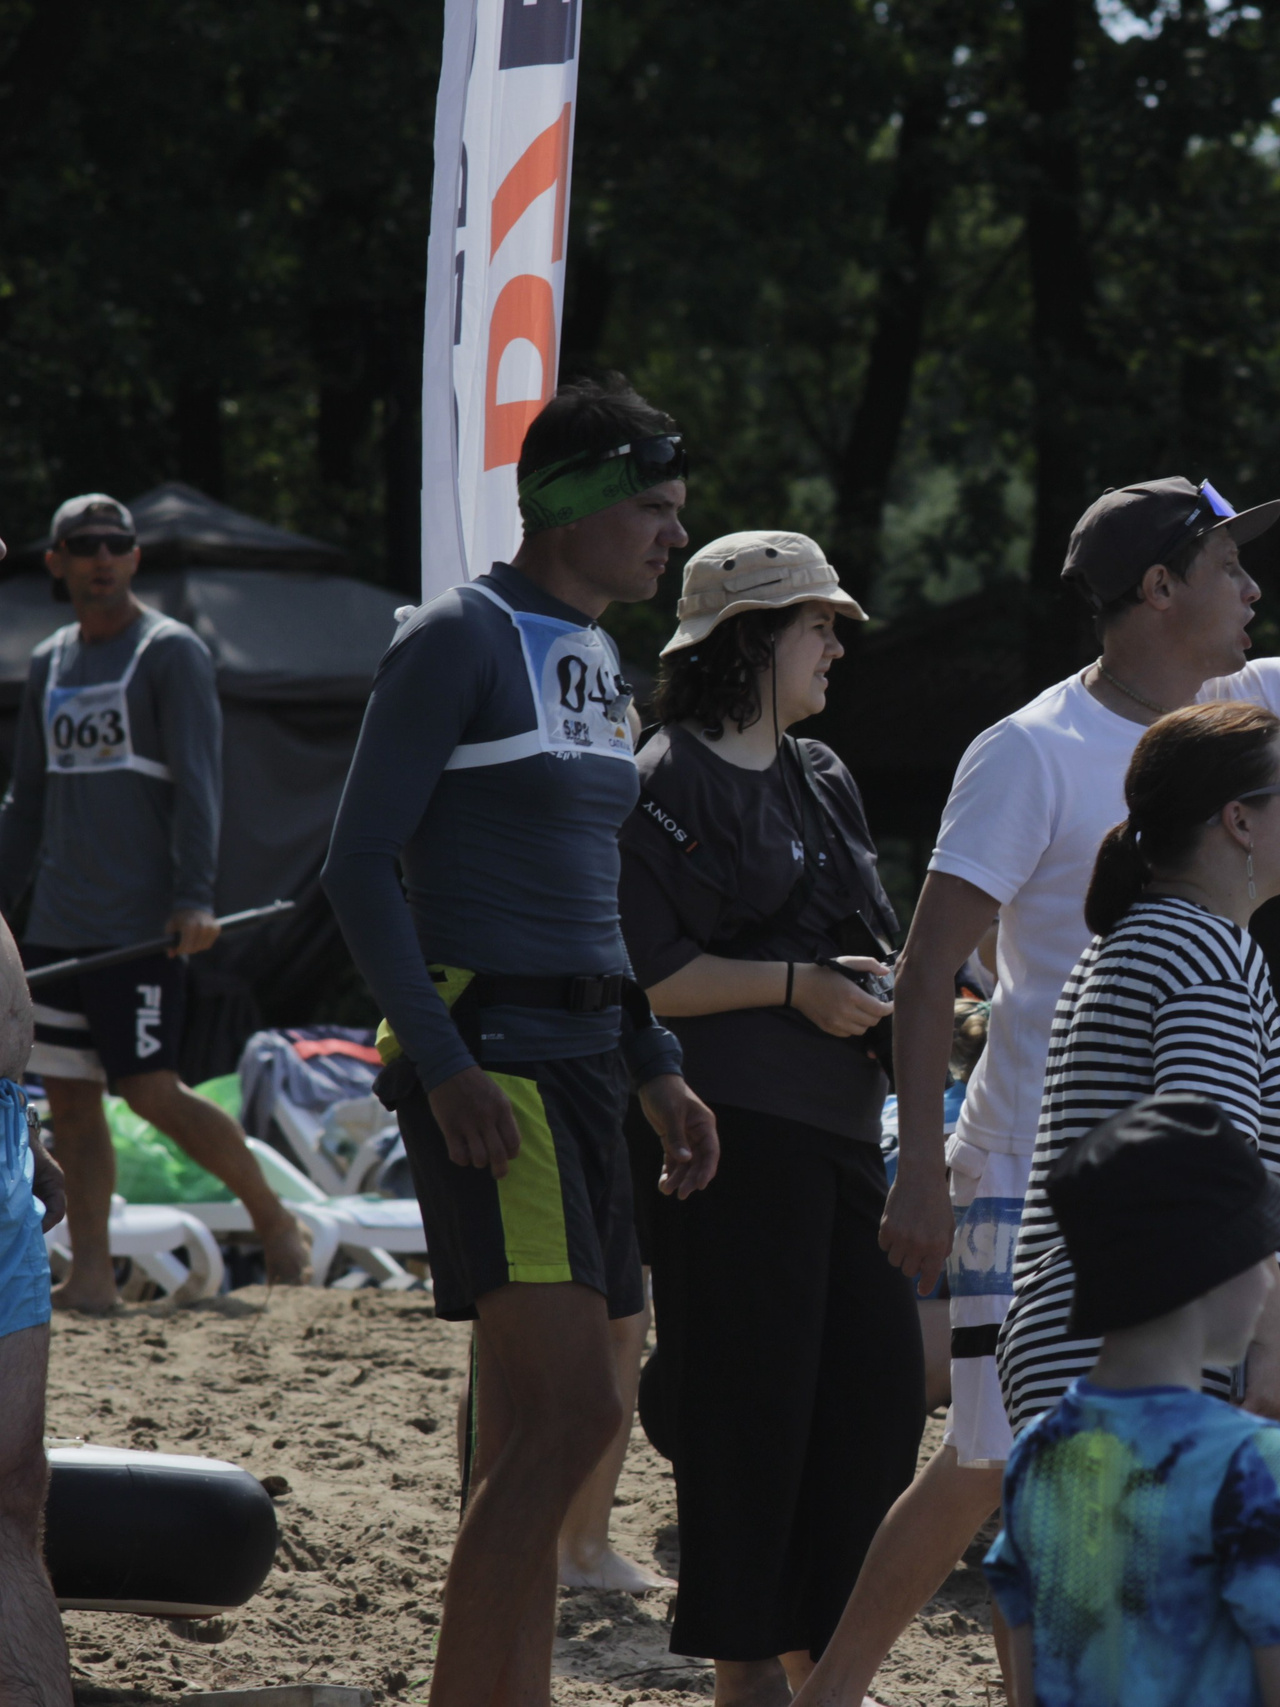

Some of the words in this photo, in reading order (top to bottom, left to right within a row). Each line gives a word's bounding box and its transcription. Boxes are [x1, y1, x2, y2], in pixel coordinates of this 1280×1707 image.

[54, 709, 125, 749] 063
[641, 800, 688, 842] SONY
[135, 983, 162, 1059] FILA
